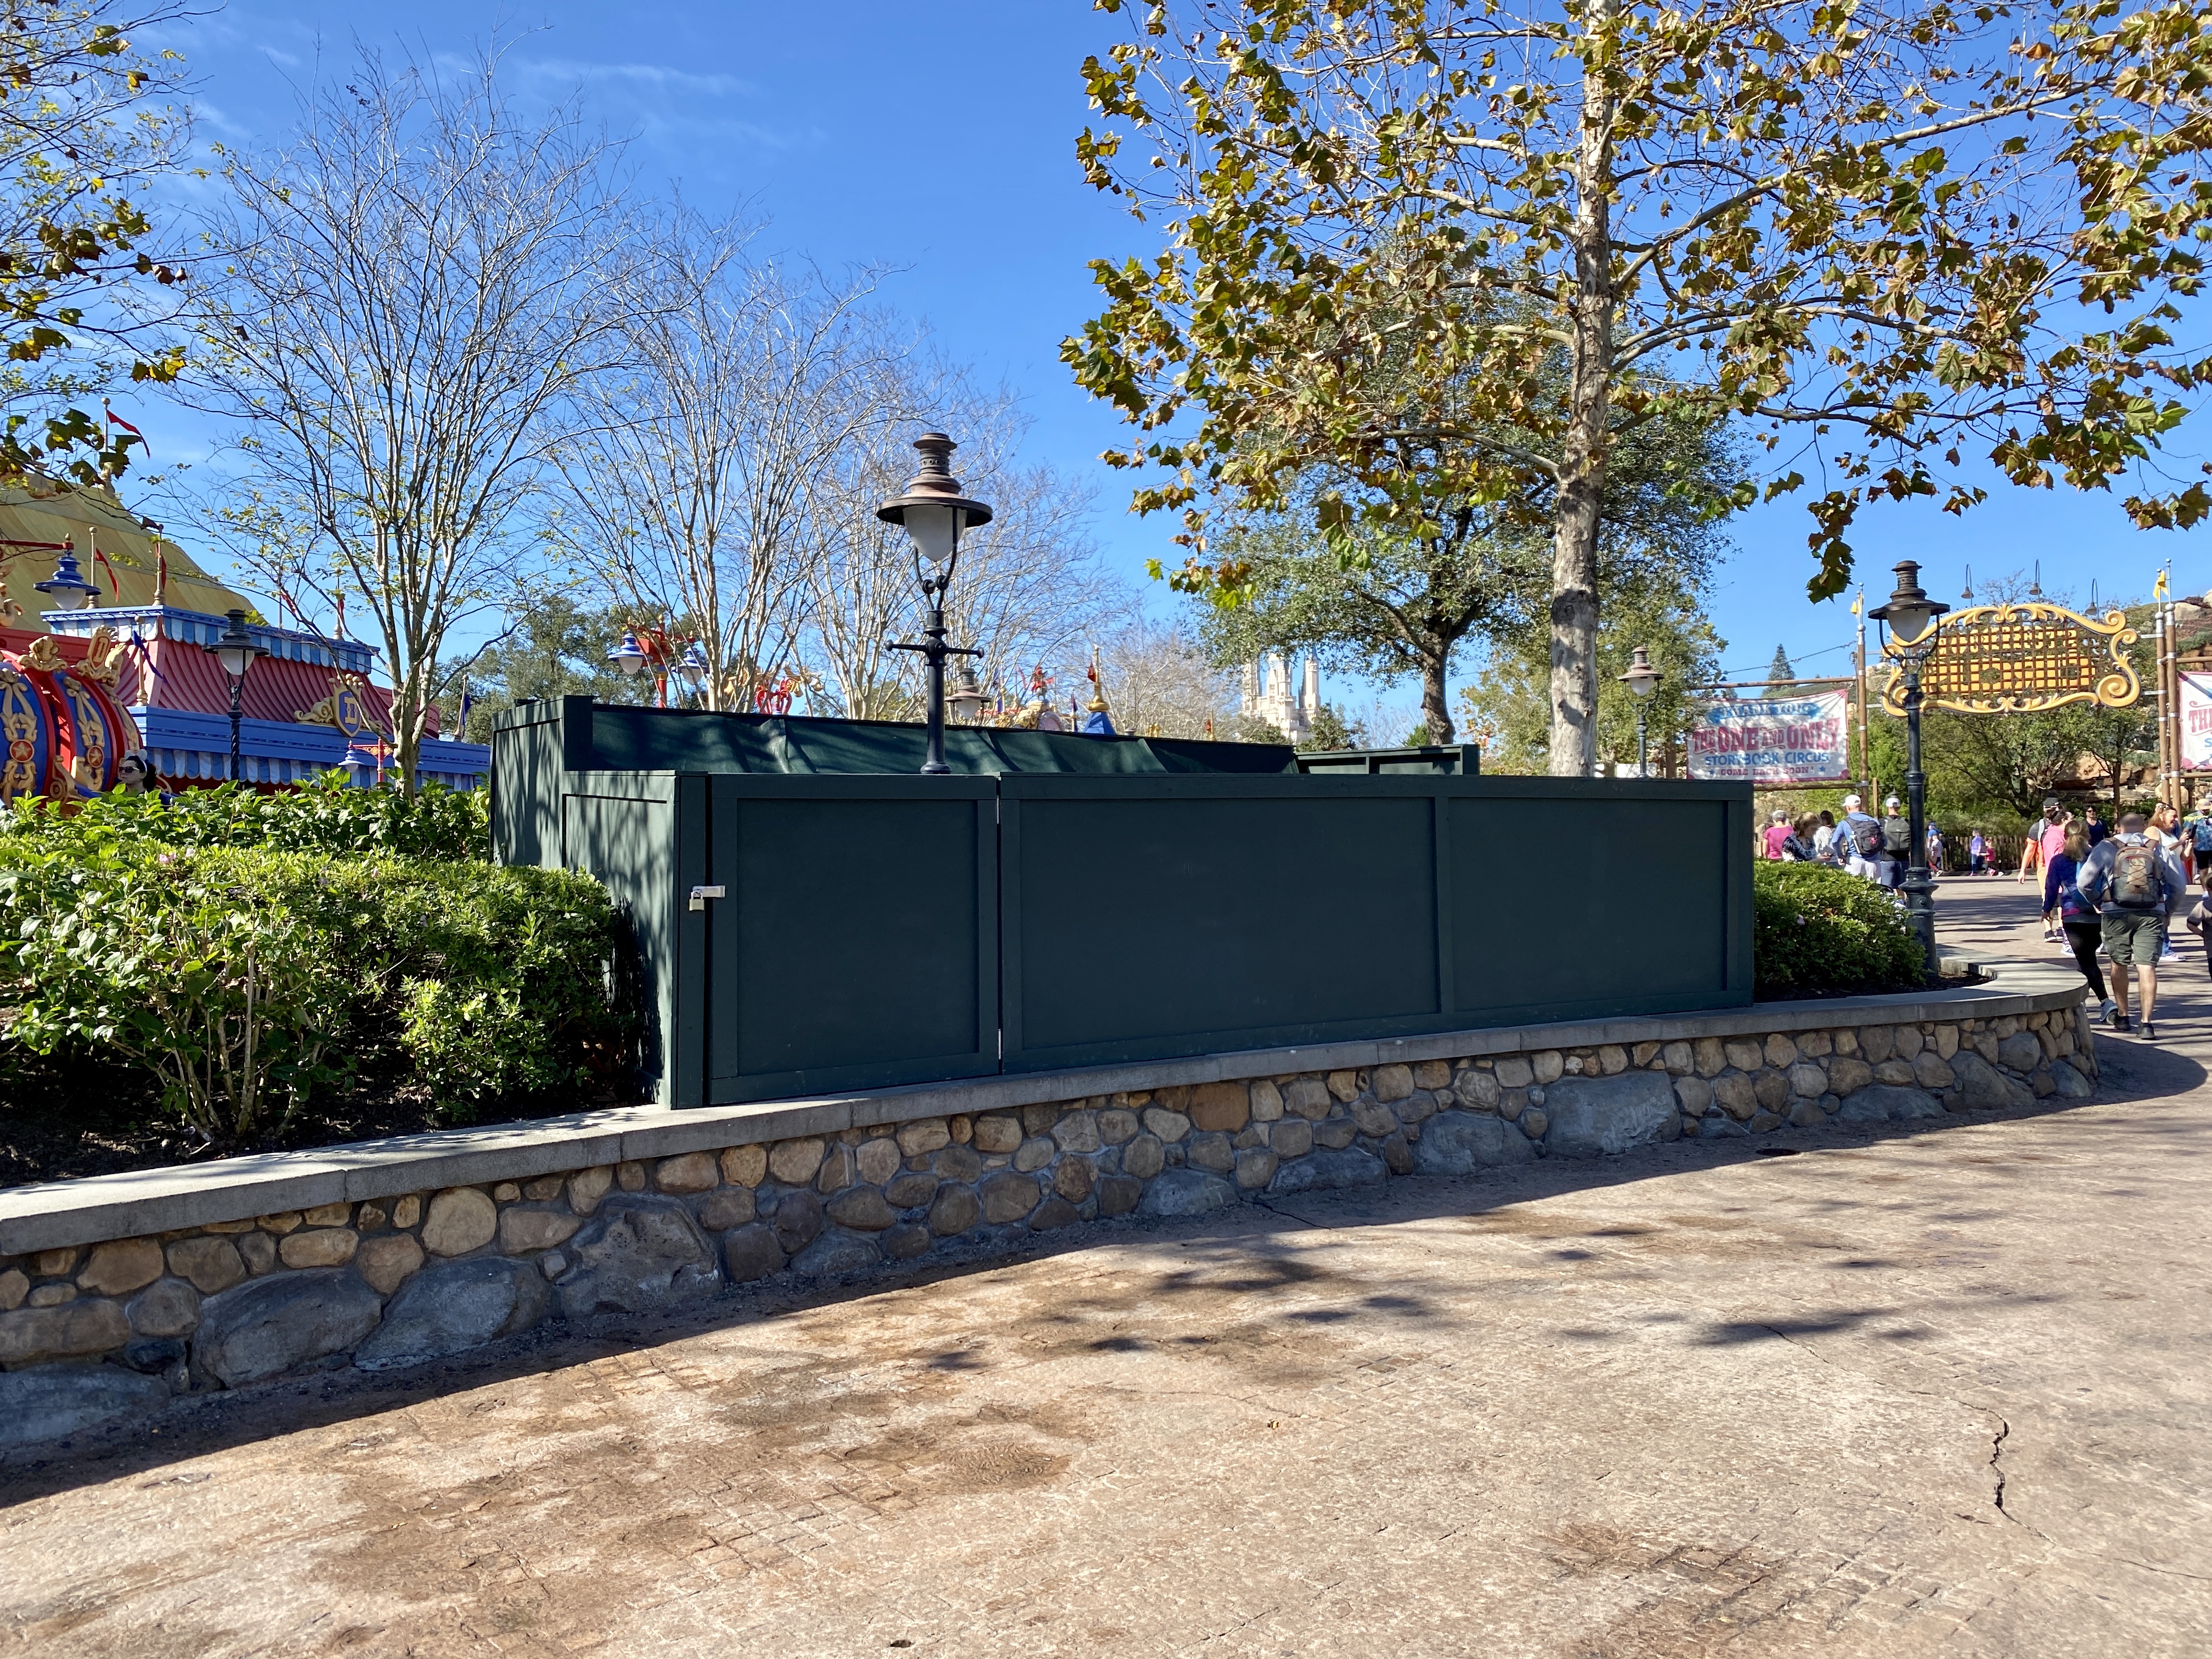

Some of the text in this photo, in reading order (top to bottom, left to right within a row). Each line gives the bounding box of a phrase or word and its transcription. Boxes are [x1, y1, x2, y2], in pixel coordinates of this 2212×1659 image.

[344, 696, 358, 724] D
[1692, 718, 1840, 752] THE ONE AND ONLY
[1705, 752, 1829, 765] STORYBOOK CIRCUS
